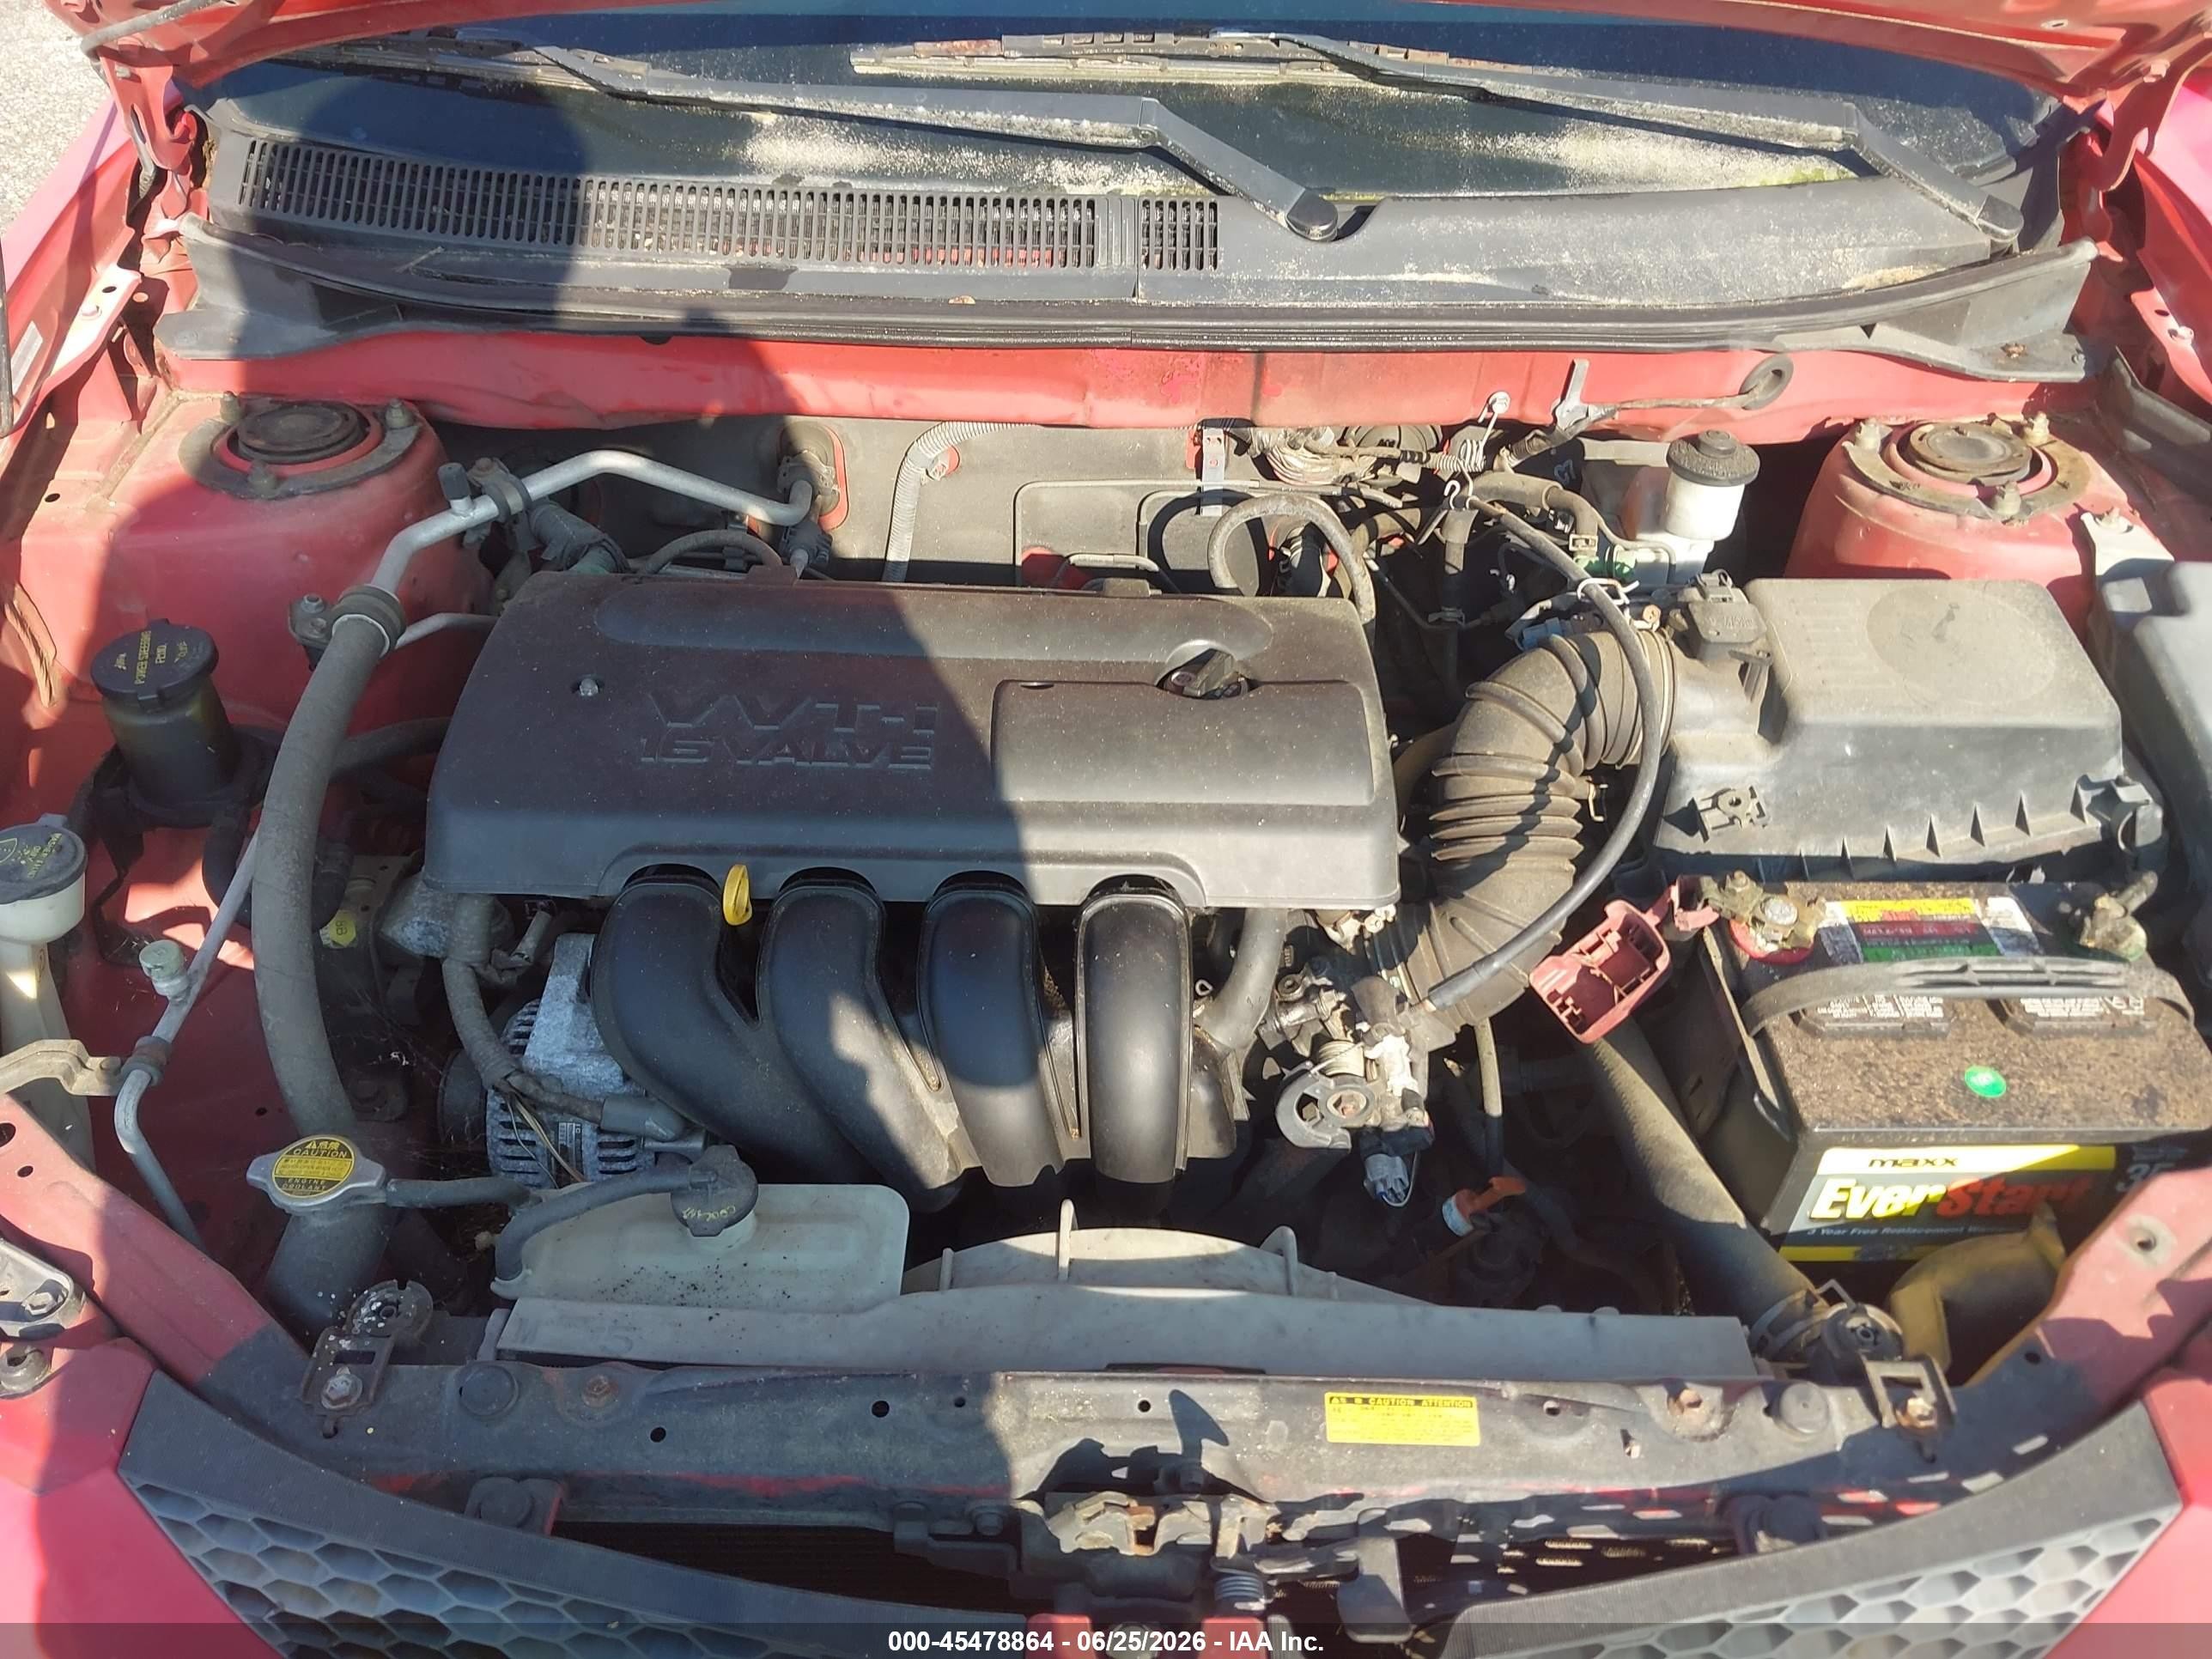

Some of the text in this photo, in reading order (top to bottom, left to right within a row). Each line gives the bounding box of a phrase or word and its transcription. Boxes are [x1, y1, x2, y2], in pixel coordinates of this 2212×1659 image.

[293, 1149, 347, 1158] CAUTION
[1869, 1158, 1959, 1168] maxx
[1850, 1227, 1878, 1236] Free
[1881, 1225, 1964, 1235] Replacement
[1369, 1396, 1415, 1407] CAUTION
[1421, 1398, 1473, 1408] ATTENTION
